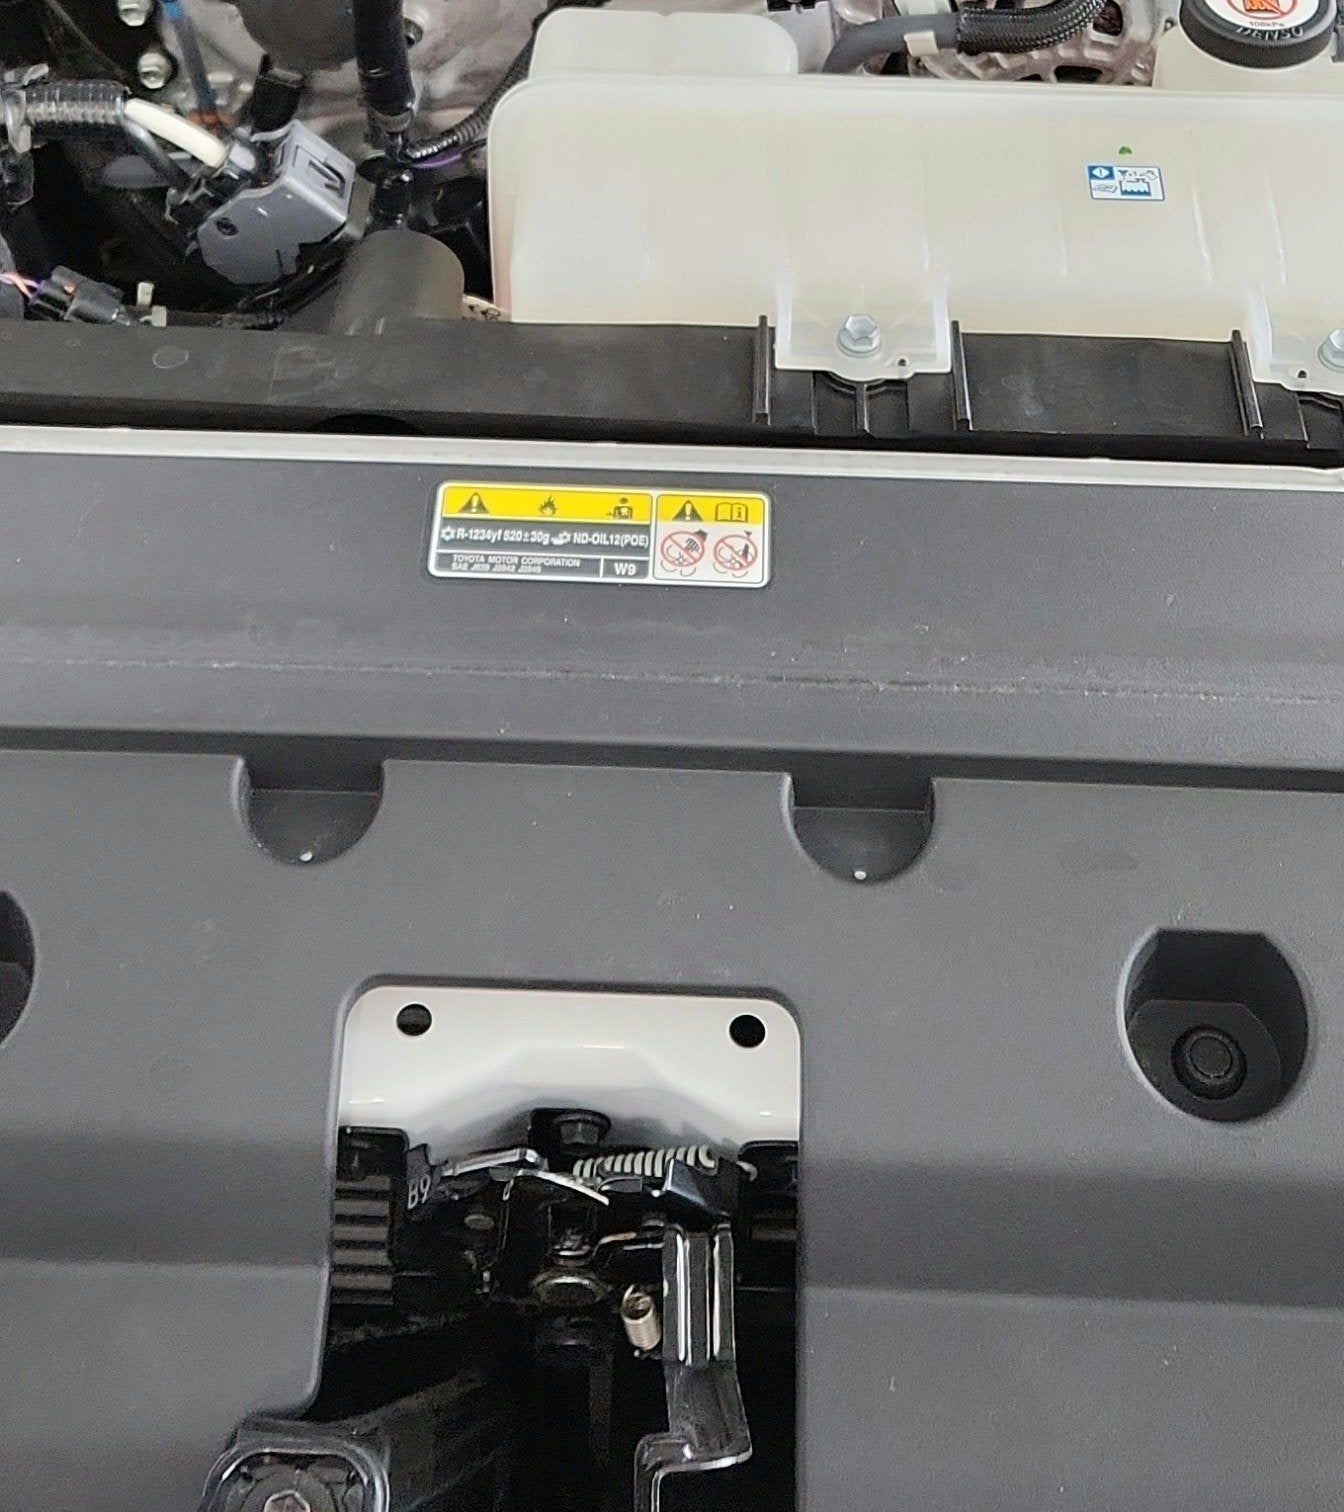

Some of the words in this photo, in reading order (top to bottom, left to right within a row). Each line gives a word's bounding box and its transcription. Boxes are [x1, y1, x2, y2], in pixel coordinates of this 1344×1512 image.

[1236, 26, 1304, 41] DENSO
[456, 526, 503, 544] R-1234yf
[503, 528, 550, 546] 520±30g
[572, 532, 650, 549] ND-OIL12(POE)
[452, 554, 485, 564] TOYOTA
[487, 555, 519, 565] MOTOR
[520, 556, 581, 568] CORPORATION
[614, 562, 637, 576] W9
[406, 1173, 431, 1210] B9
